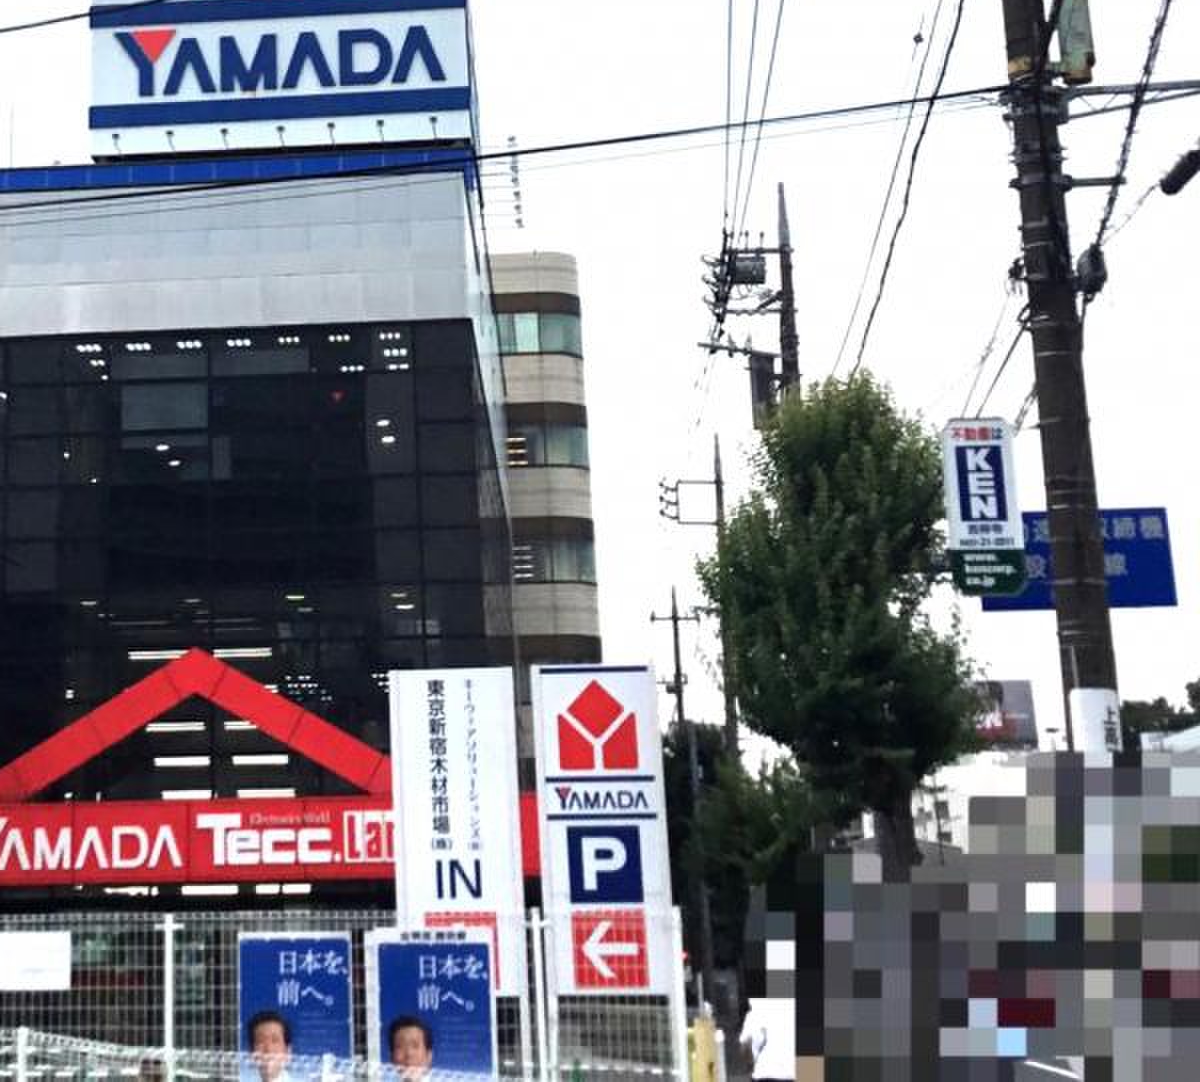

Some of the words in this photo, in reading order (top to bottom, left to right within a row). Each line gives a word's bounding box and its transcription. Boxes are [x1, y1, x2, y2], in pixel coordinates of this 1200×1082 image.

[114, 25, 446, 97] YAMADA
[965, 448, 998, 519] KEN
[555, 787, 648, 810] YAMADA
[581, 836, 627, 891] P
[435, 858, 482, 899] IN
[278, 949, 348, 975] 日本を、
[418, 953, 488, 980] 日本を、
[276, 978, 335, 1006] 前へ。
[416, 983, 475, 1012] 前へ。
